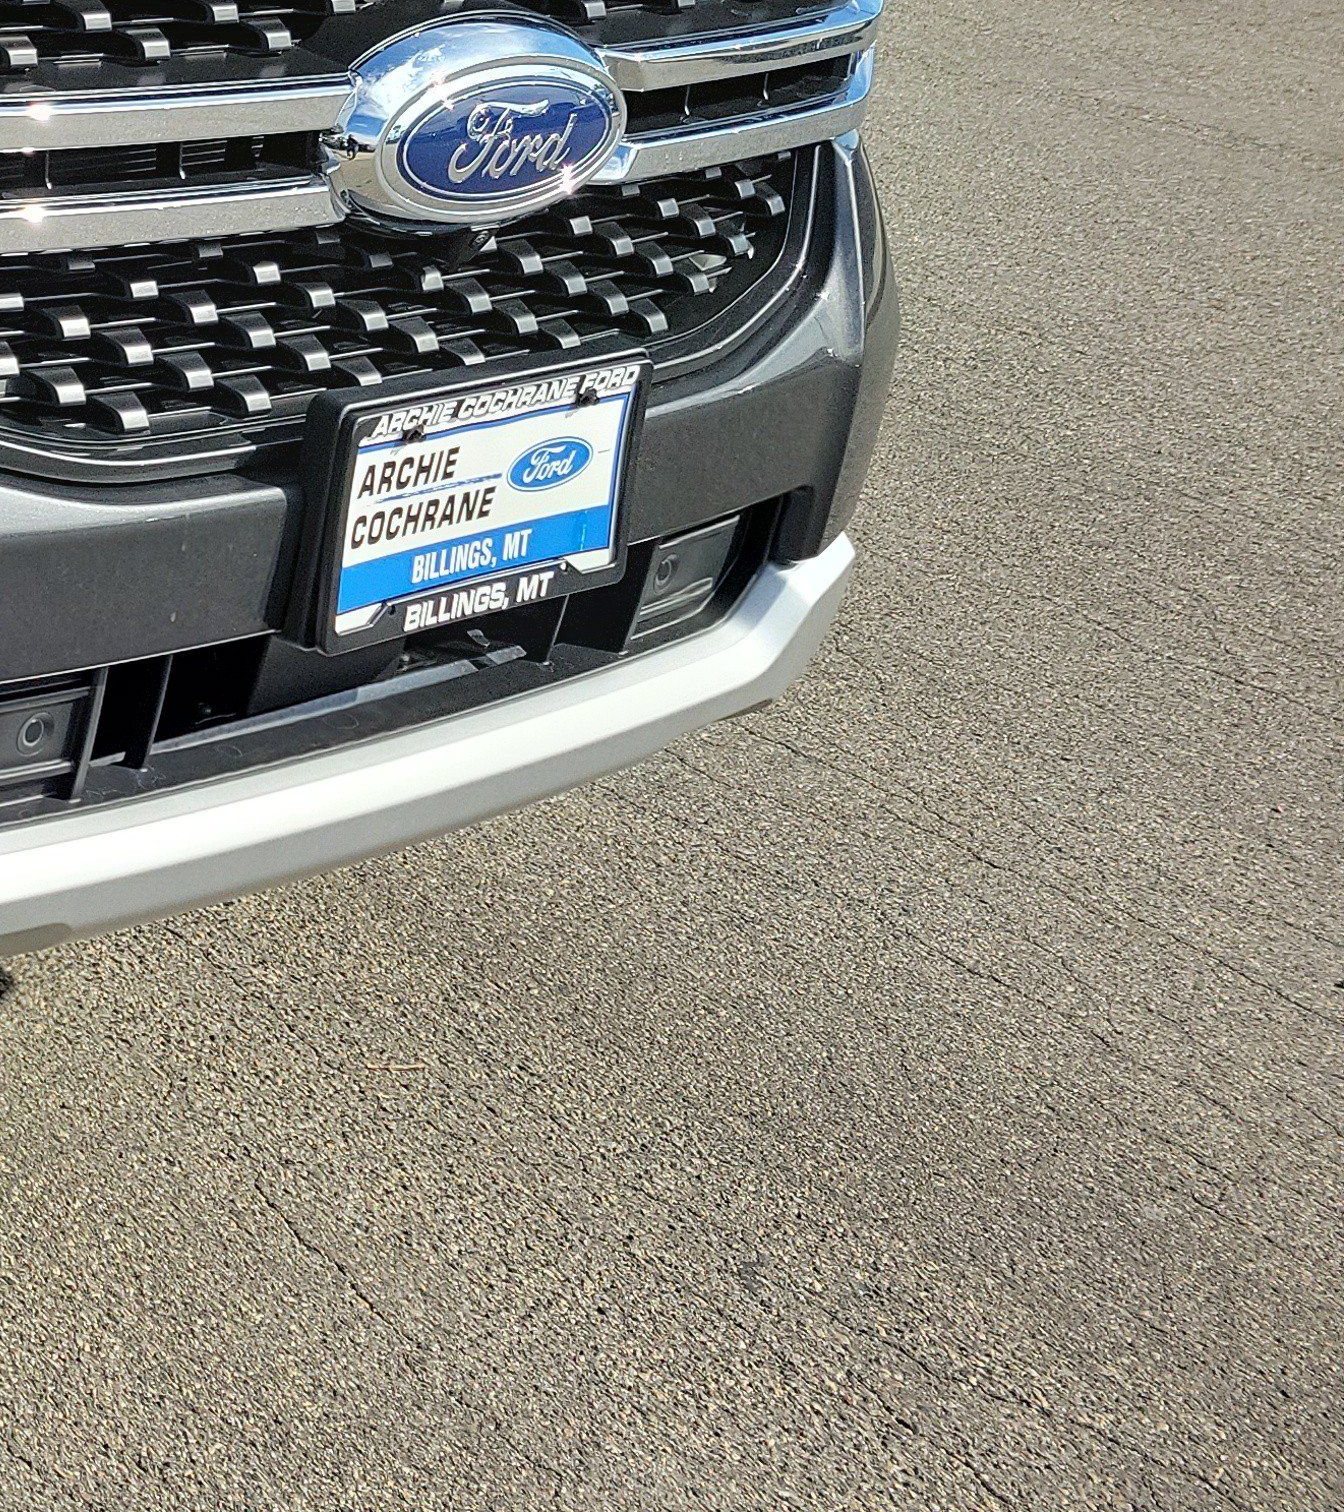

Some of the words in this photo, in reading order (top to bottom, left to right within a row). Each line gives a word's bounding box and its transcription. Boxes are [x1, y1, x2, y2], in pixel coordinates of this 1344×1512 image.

[448, 99, 578, 184] Ford
[372, 401, 458, 438] ARCHIE
[457, 376, 580, 419] COCHRANE
[579, 365, 640, 394] FORD
[357, 446, 460, 499] ARCHIE
[523, 445, 577, 483] Ford
[351, 486, 497, 549] COCHRANE
[411, 537, 497, 584] BILLINGS,
[502, 528, 533, 561] MT
[403, 582, 509, 632] BILLINGS,
[516, 571, 555, 603] MT
